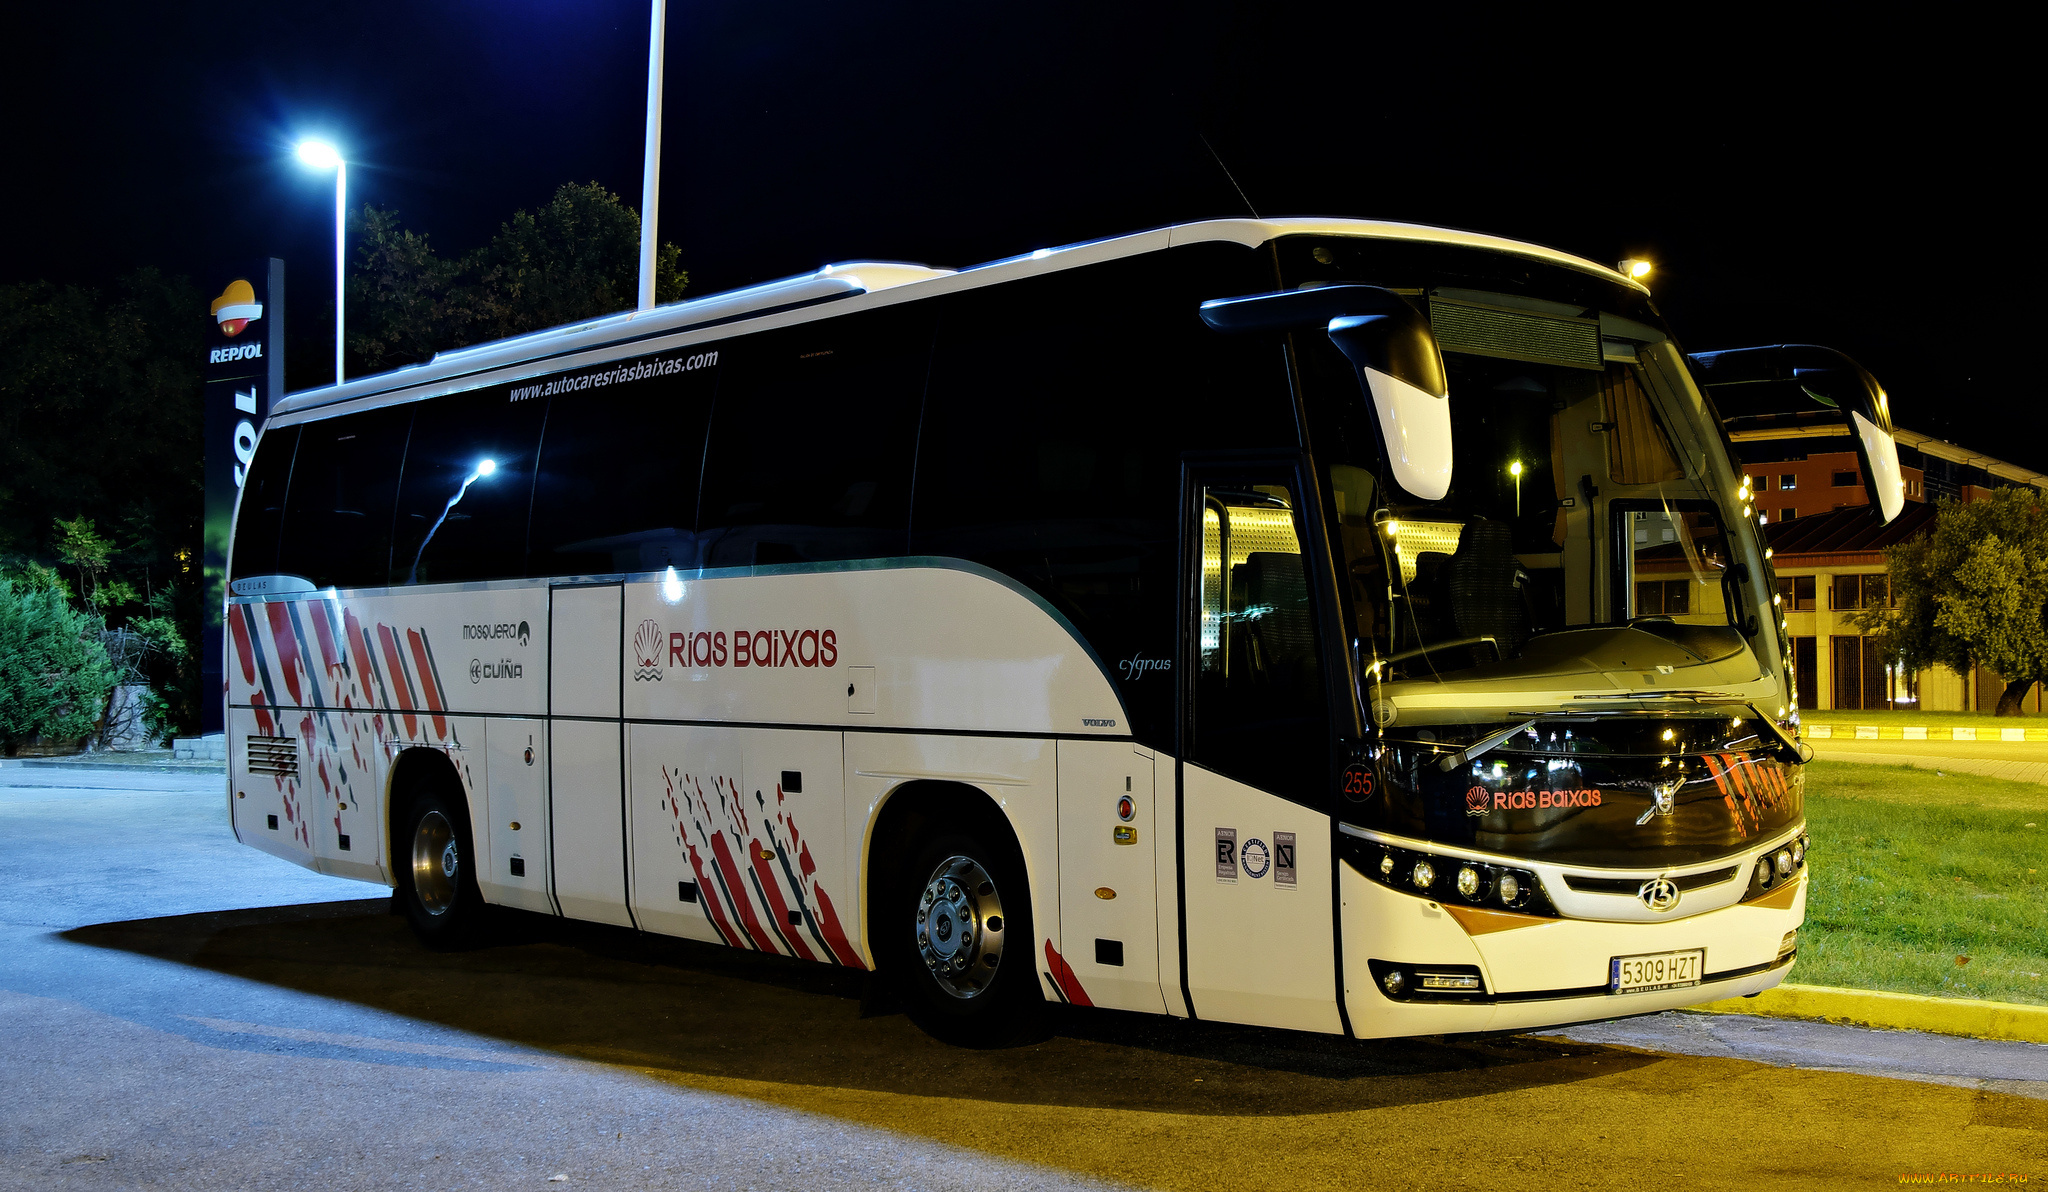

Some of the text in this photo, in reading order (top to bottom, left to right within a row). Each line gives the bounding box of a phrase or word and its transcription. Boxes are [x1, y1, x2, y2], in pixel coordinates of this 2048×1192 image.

[210, 343, 263, 364] REPSOL
[510, 351, 719, 402] www.autocaresriasbaixas.com
[1119, 651, 1172, 680] cygnus
[1082, 718, 1117, 727] VOLVO
[1344, 771, 1373, 795] 255
[1613, 977, 1619, 985] E
[1623, 956, 1698, 985] 5309 HZT
